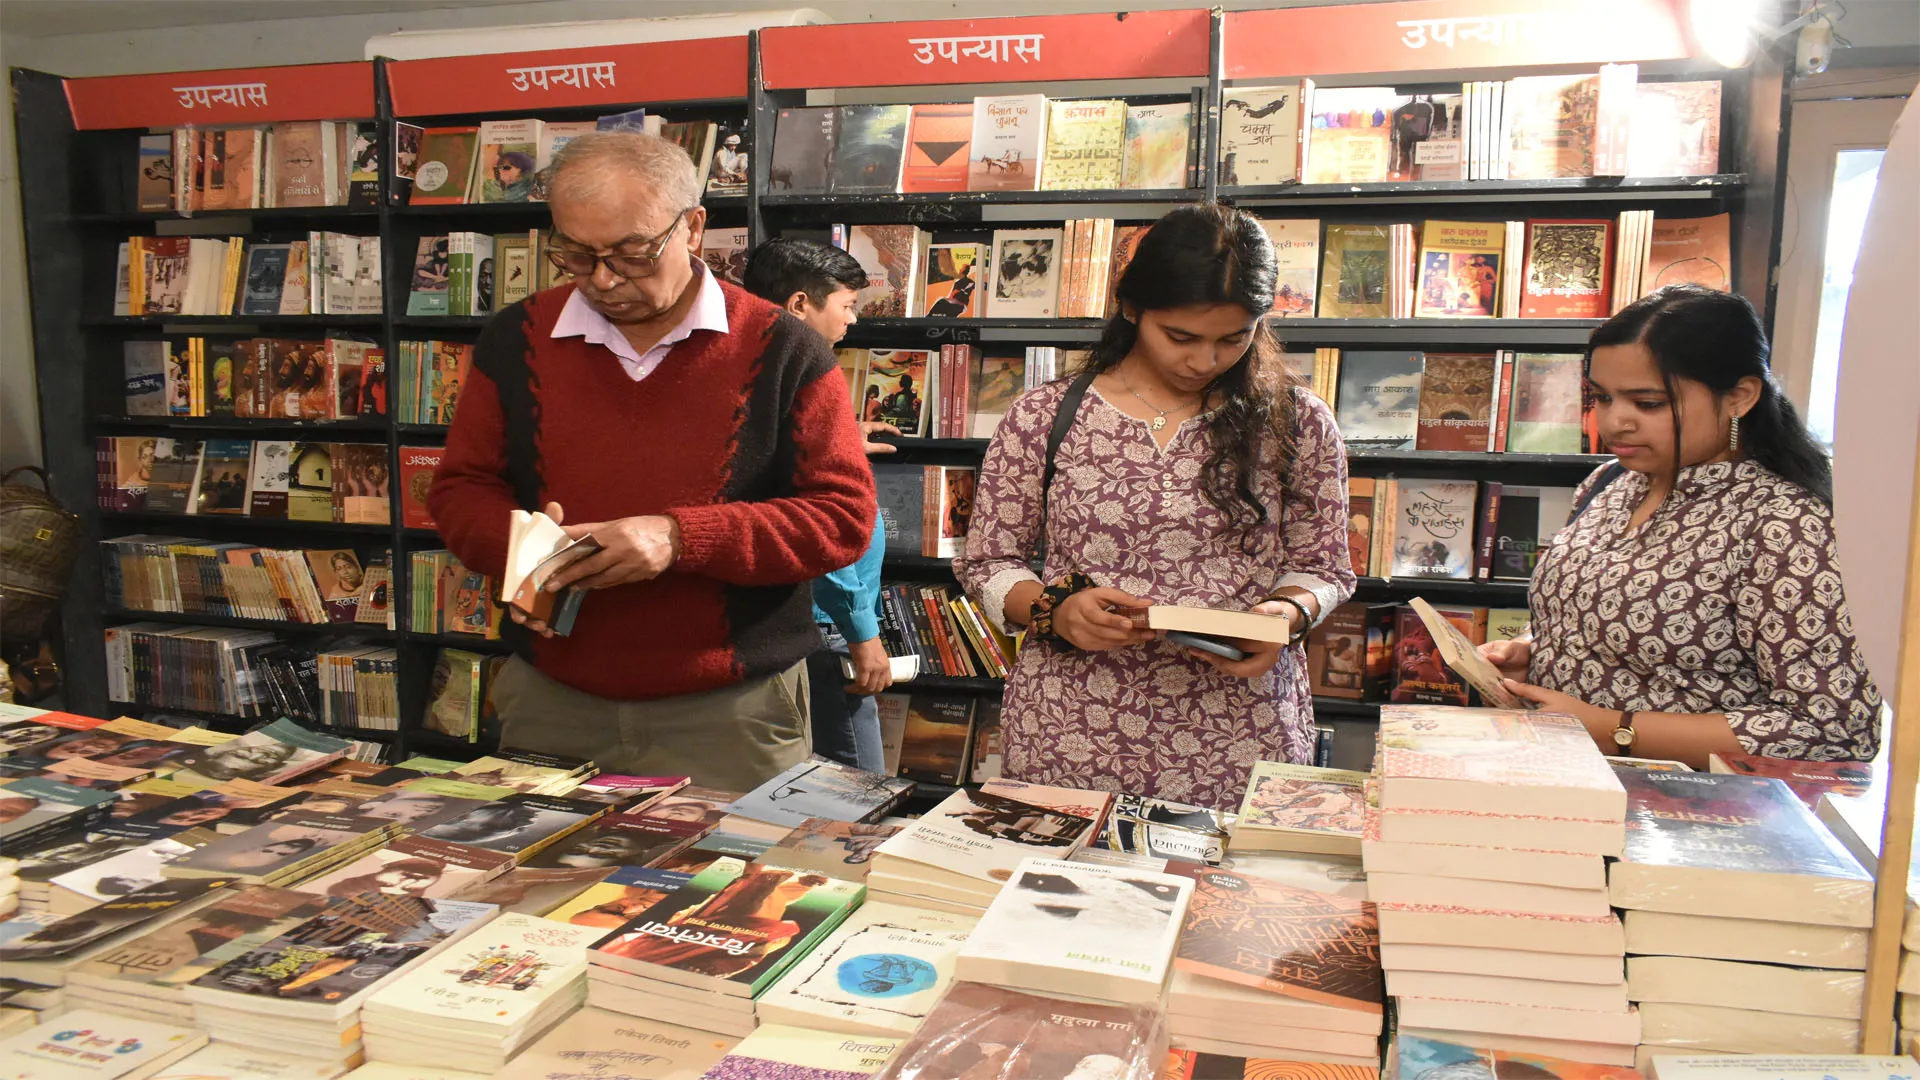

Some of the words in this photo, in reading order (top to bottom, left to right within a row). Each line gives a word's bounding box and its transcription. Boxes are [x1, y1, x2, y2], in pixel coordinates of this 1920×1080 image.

[1396, 14, 1530, 49] उपन्या
[908, 33, 1045, 65] उपन्यास
[506, 61, 616, 92] उपन्यास
[172, 83, 267, 109] उपन्यास
[1527, 287, 1551, 297] राहुल
[1553, 287, 1602, 298] सांकृत्यायन
[1420, 418, 1442, 428] राहुल
[1444, 417, 1489, 430] सांकृत्यायन
[634, 921, 756, 955] चित्रलेखा
[1050, 1013, 1101, 1028] मृदुला
[1105, 1021, 1134, 1031] गर्ग
[614, 1028, 649, 1042] राकेश
[651, 1032, 691, 1049] तिवारी
[859, 1058, 885, 1067] मृदुल
